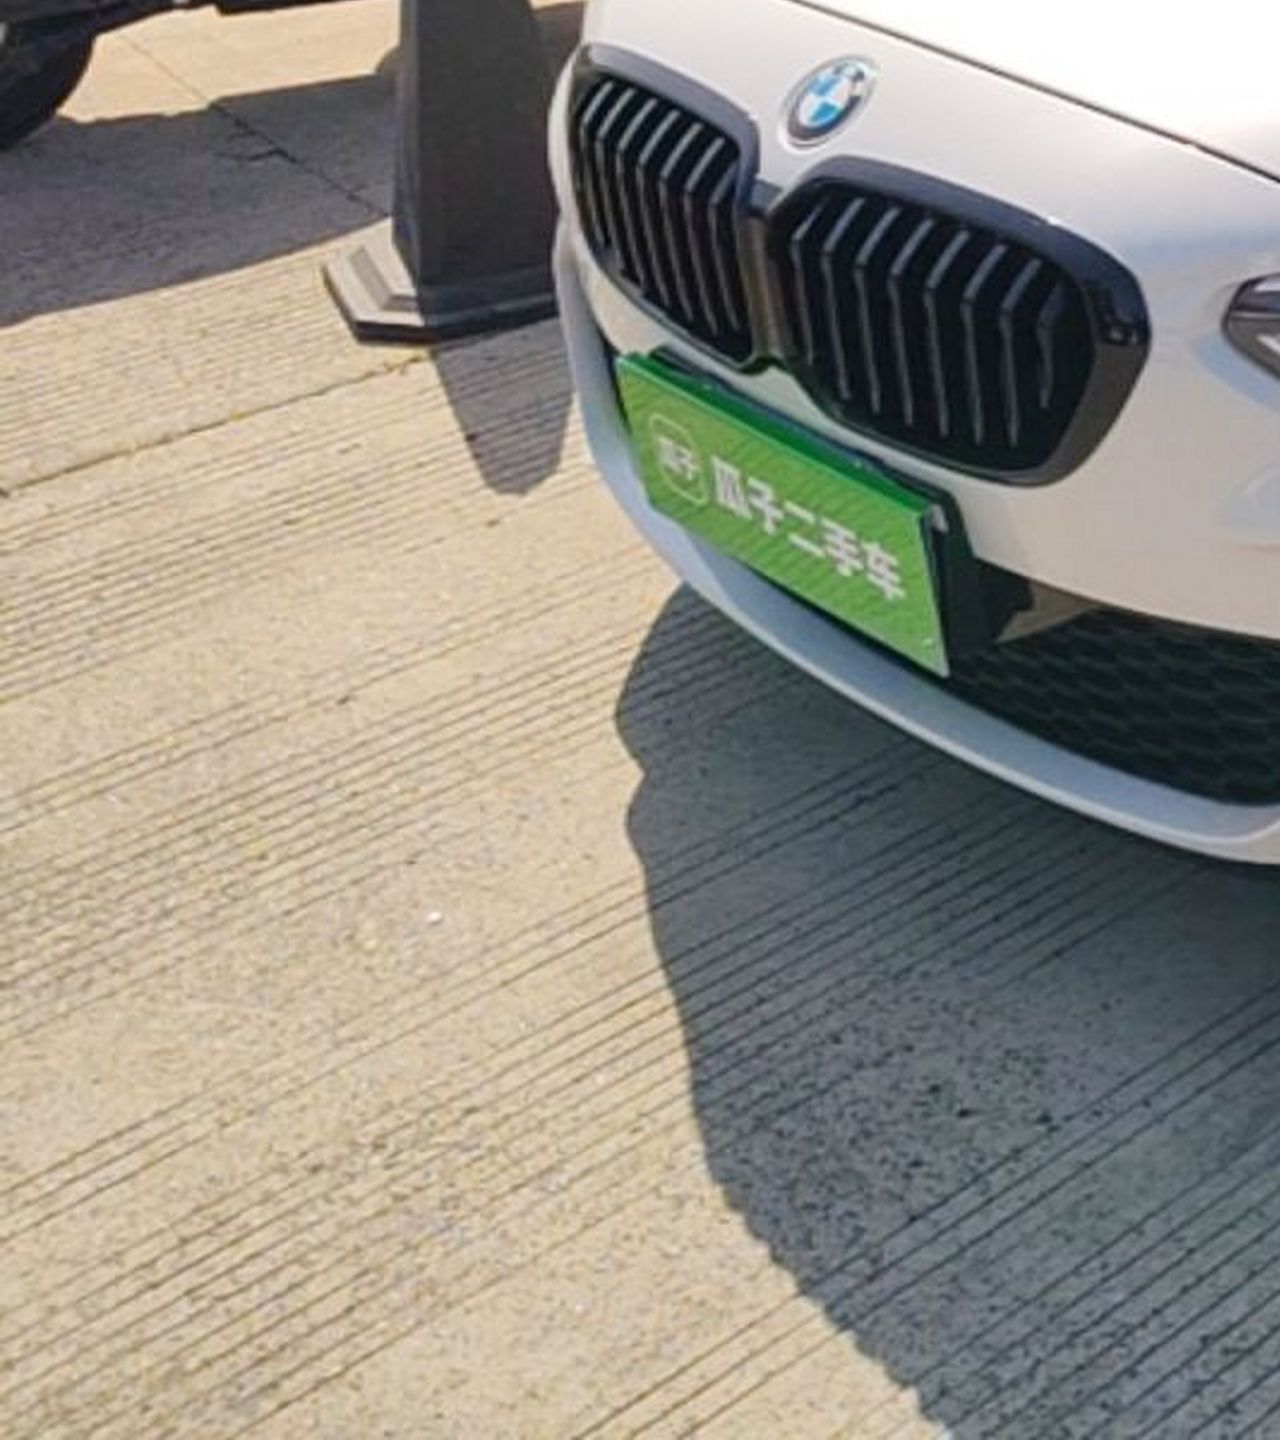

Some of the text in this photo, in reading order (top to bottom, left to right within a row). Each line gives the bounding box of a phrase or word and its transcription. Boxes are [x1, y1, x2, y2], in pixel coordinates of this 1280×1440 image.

[710, 455, 906, 601] 瓜子二手车
